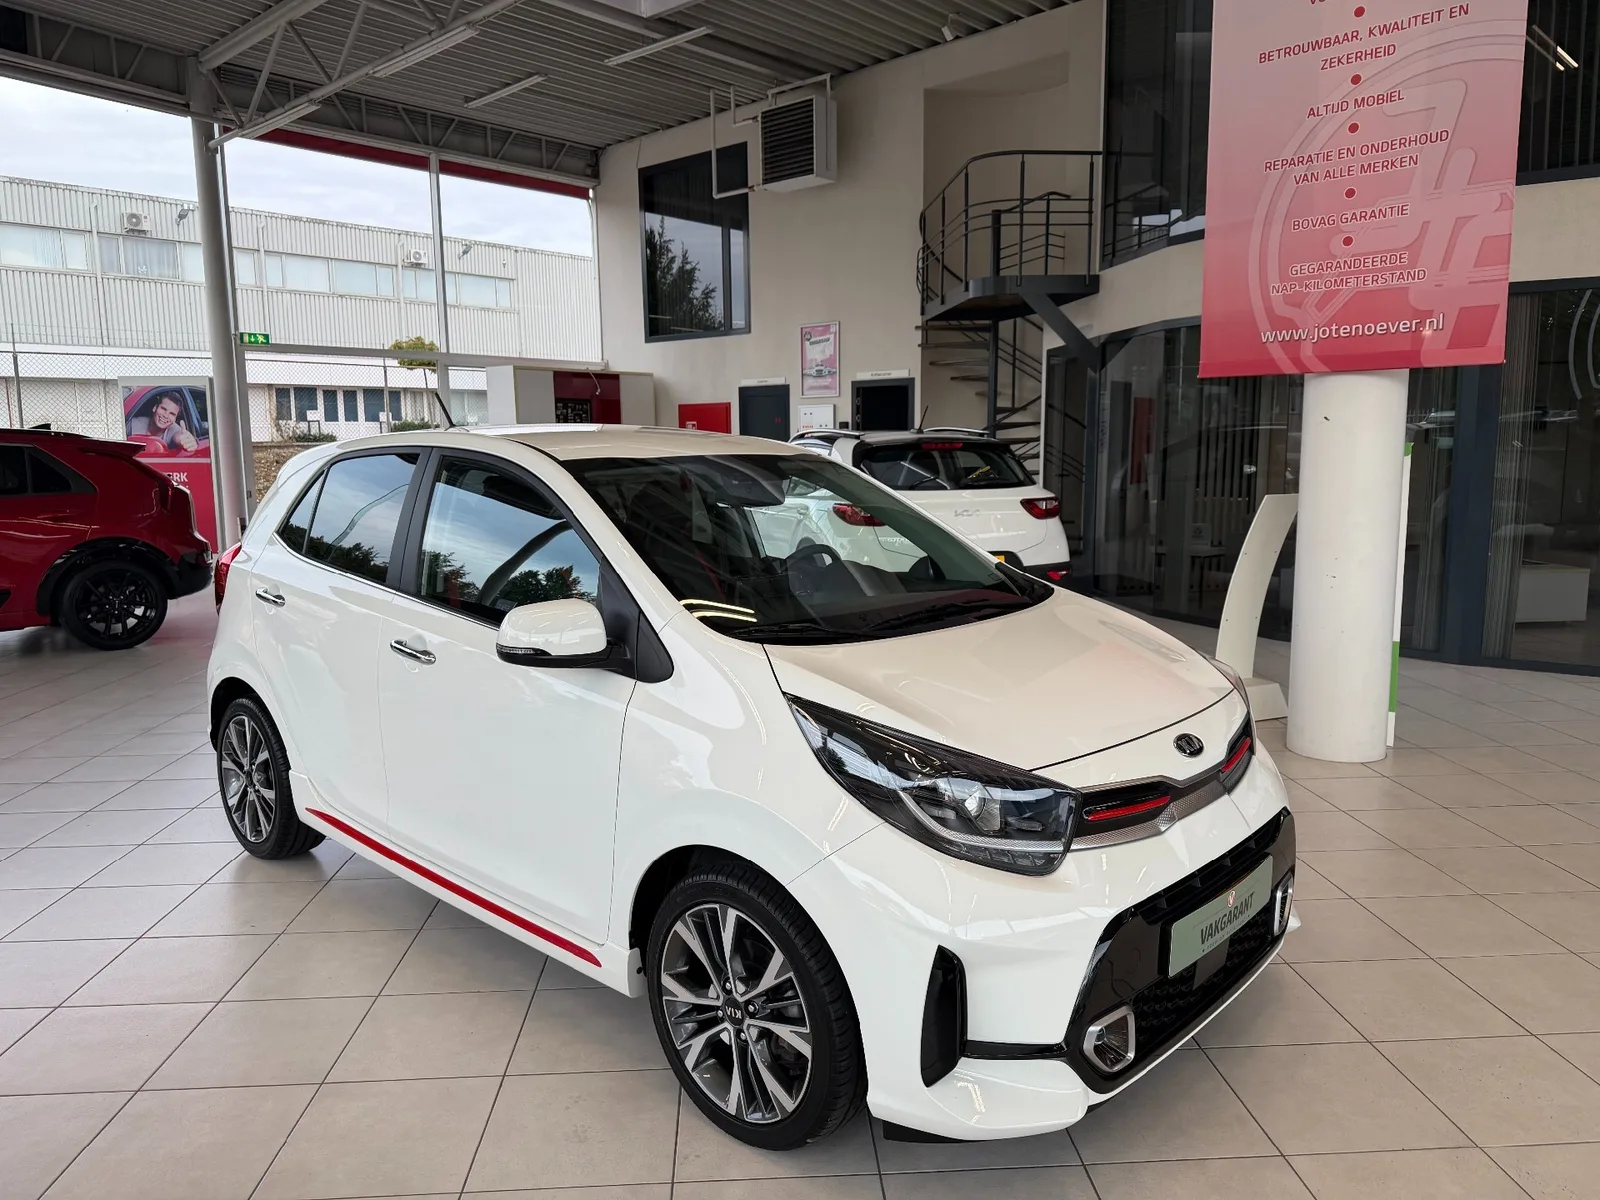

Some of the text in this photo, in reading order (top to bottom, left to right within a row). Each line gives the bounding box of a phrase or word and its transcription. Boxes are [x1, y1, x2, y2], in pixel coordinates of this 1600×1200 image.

[1258, 3, 1469, 64] BETROUWBAAR, KWALITEIT EN
[1320, 43, 1397, 71] ZEKERHEID
[1306, 89, 1405, 119] ALTIJD MOBIEL
[1264, 129, 1449, 173] REPARATIE EN ONDERHOUD
[1293, 154, 1419, 186] VAN ALLE MERKEN
[1292, 204, 1409, 232] BOVAG GARANTIE
[1289, 252, 1408, 277] GEGARANDEERDE
[1270, 268, 1427, 296] NAP-KILOMETERSTAND
[1260, 313, 1445, 343] www.jotenoever.nl
[1200, 892, 1255, 945] VAKGARANT
[725, 1005, 742, 1019] KIA
